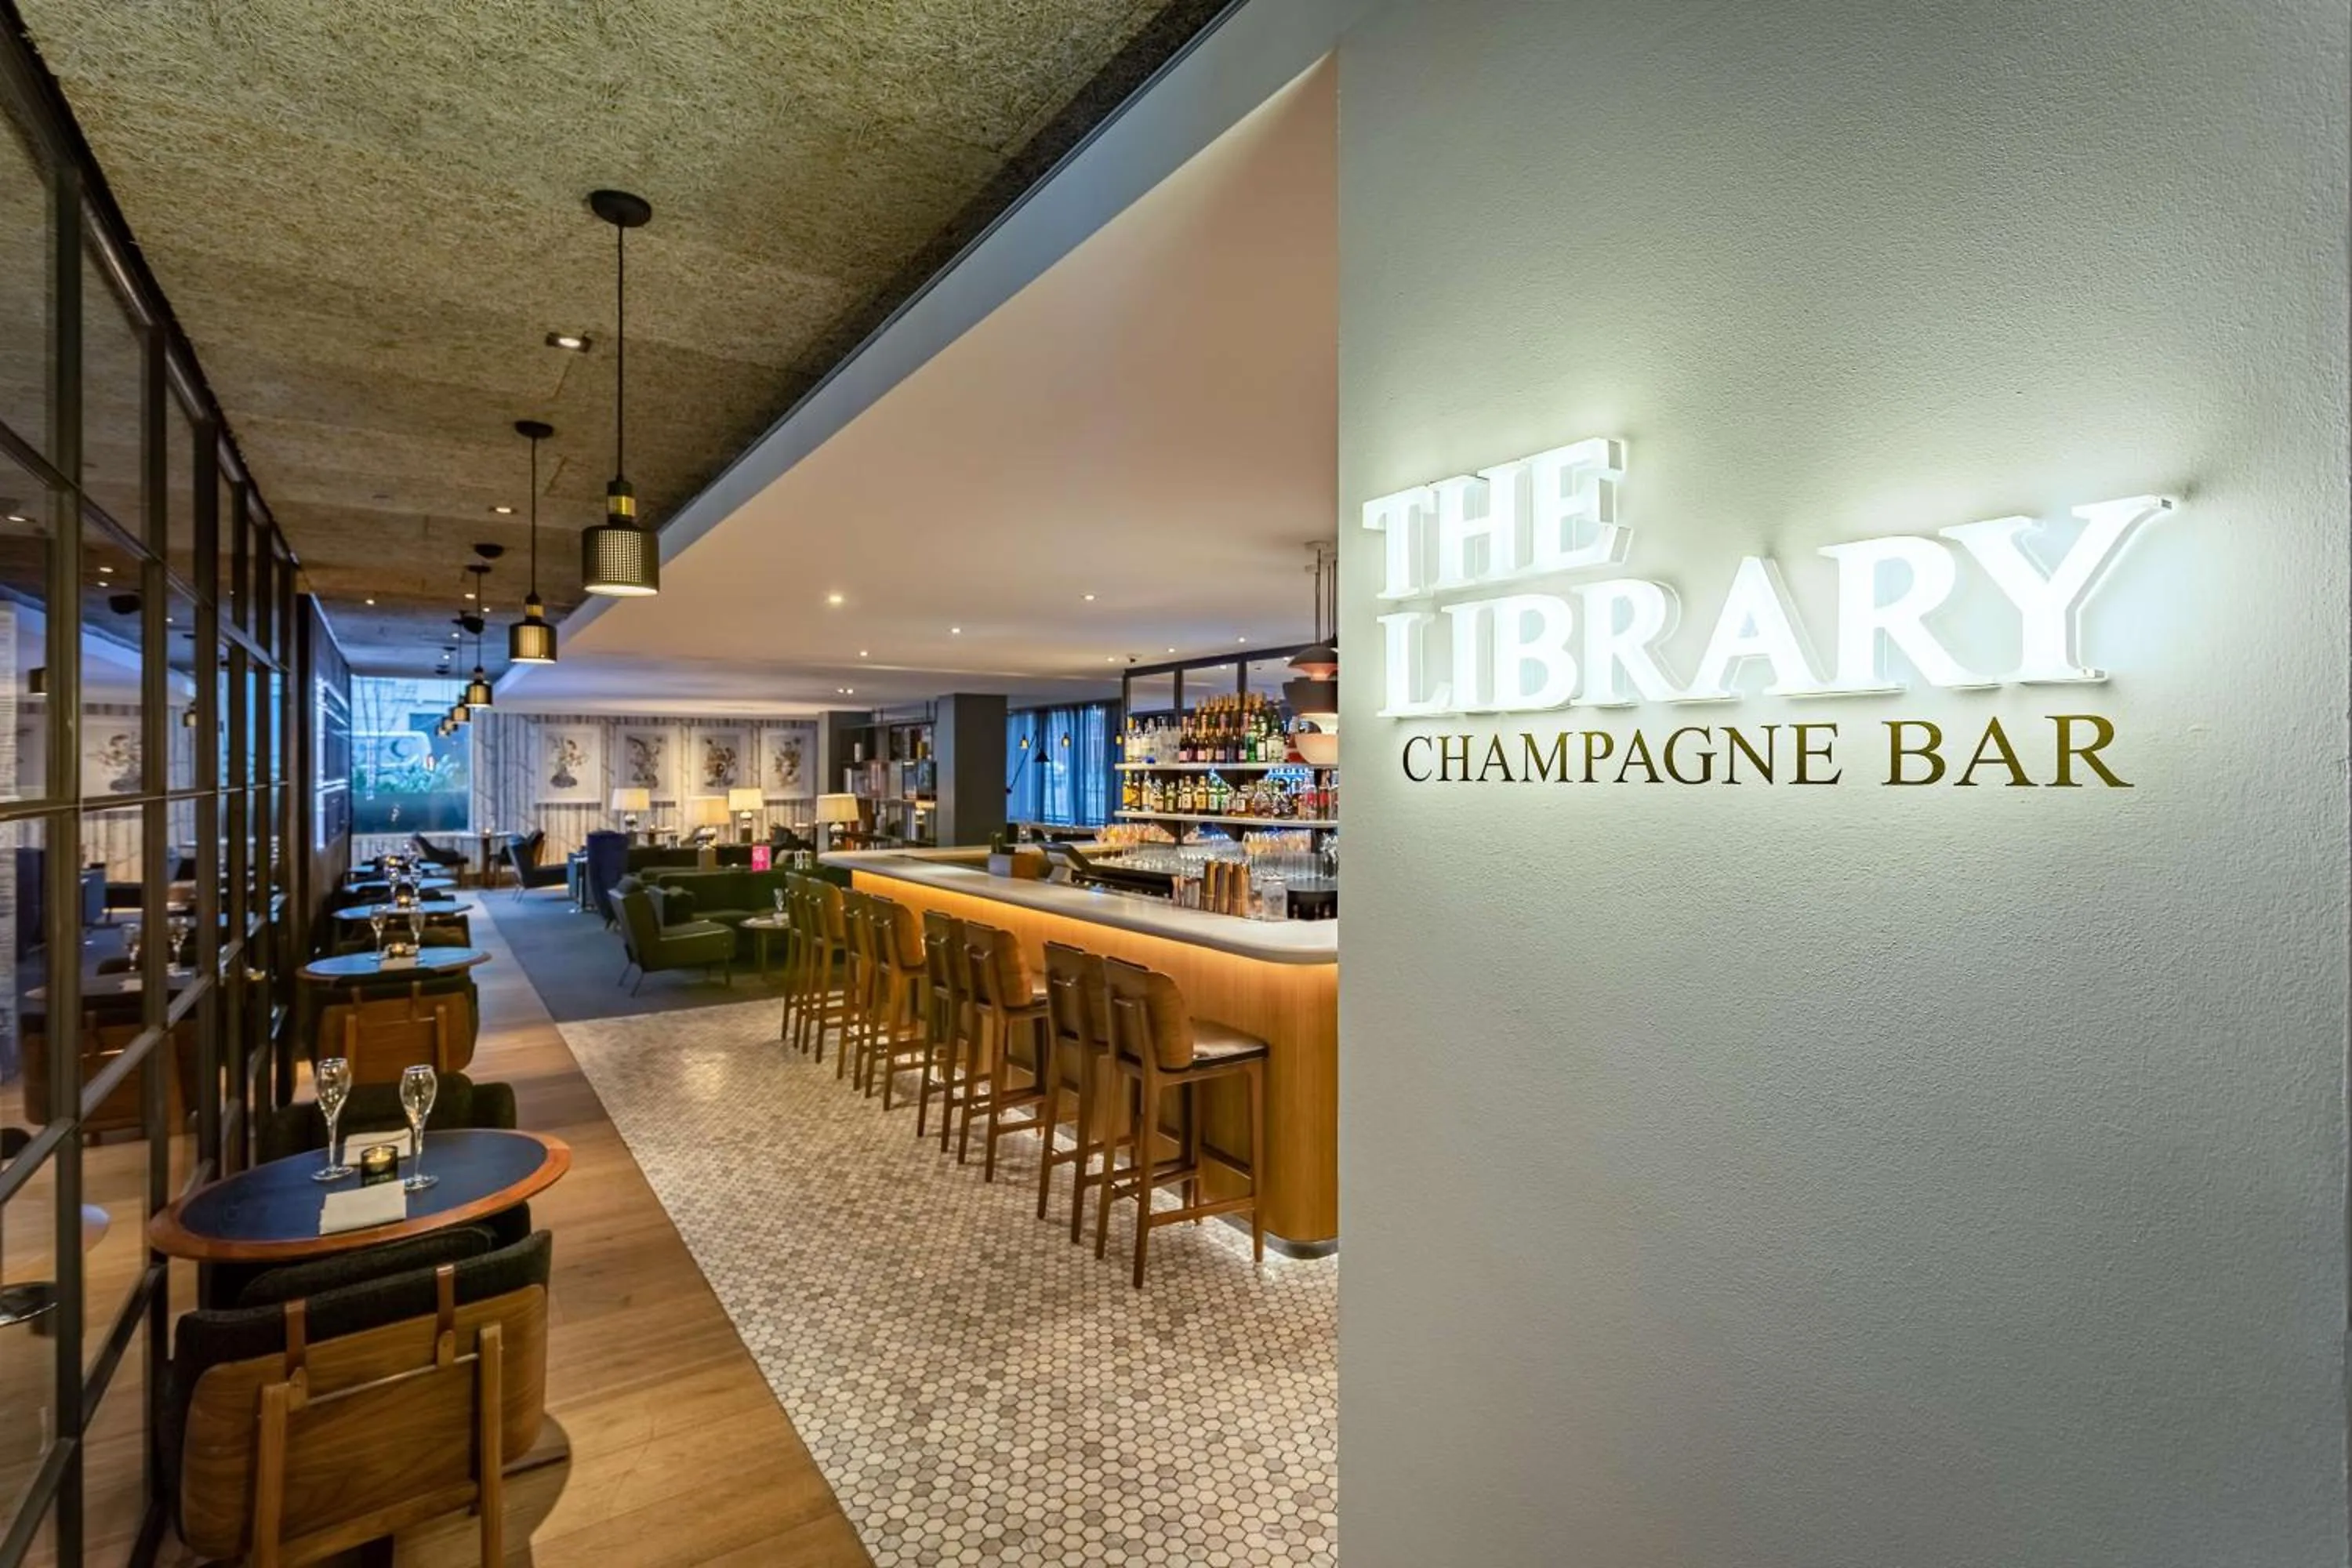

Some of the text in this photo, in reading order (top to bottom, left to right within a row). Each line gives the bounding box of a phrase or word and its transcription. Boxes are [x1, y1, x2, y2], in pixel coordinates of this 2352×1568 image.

[1362, 437, 1633, 601] THE
[1377, 494, 2173, 717] LIBRARY
[1402, 714, 2134, 788] CHAMPAGNE BAR
